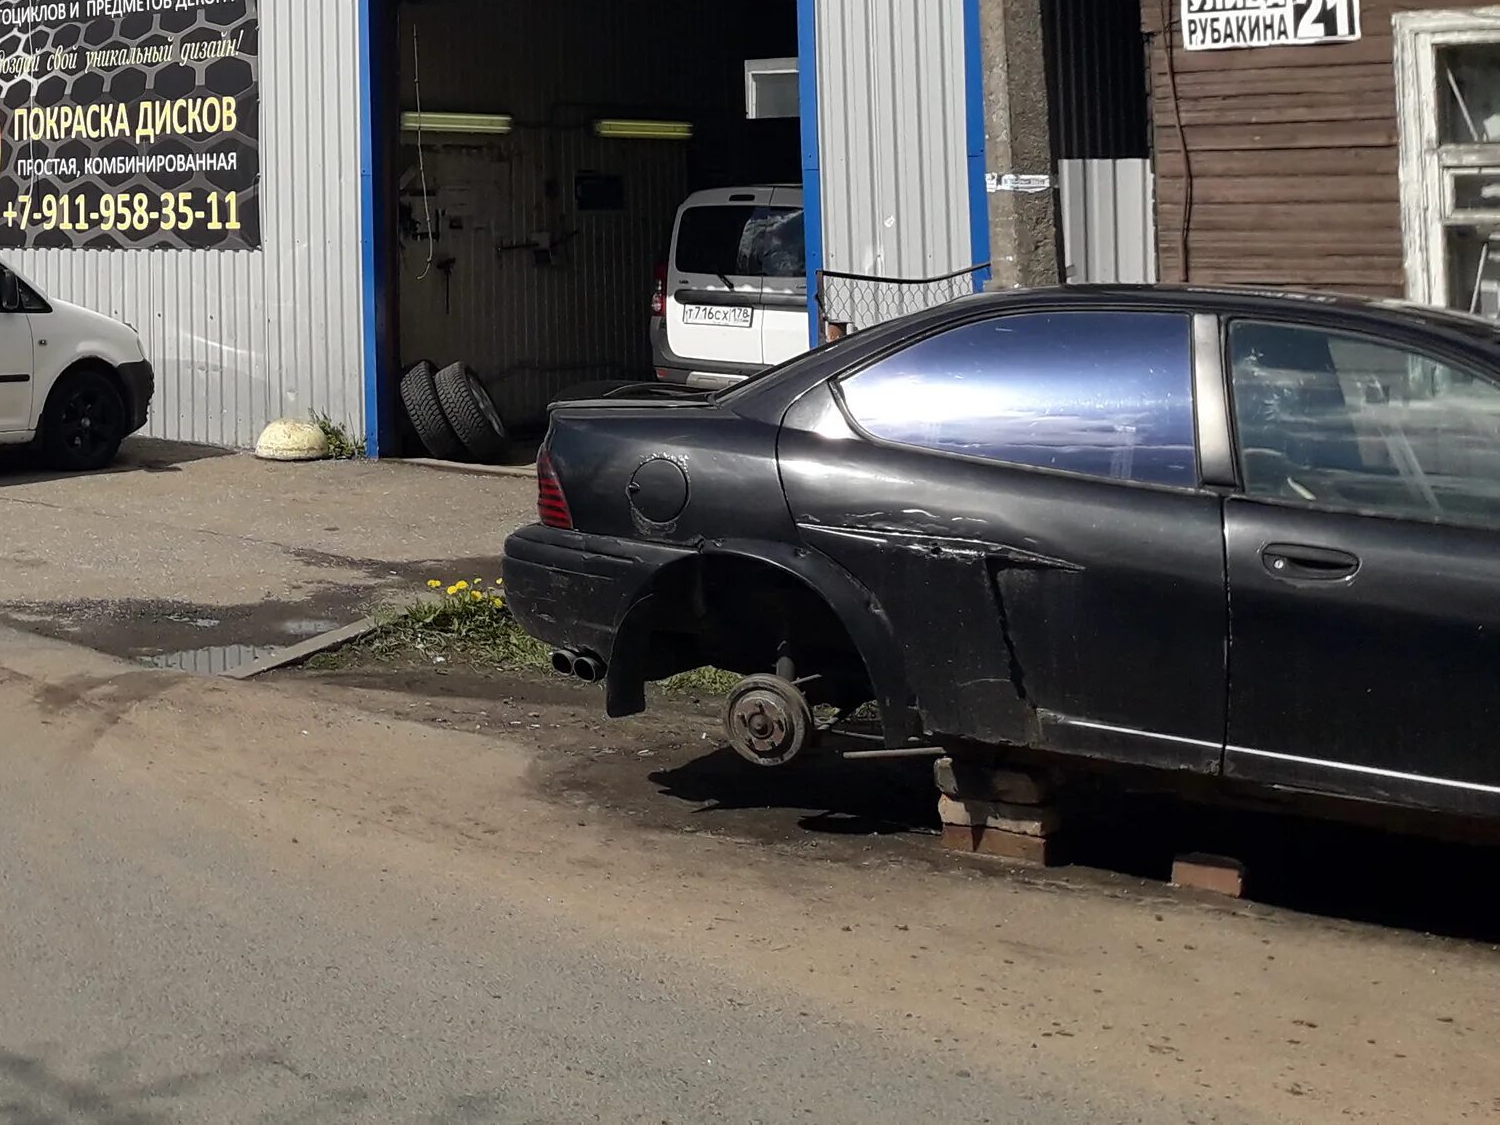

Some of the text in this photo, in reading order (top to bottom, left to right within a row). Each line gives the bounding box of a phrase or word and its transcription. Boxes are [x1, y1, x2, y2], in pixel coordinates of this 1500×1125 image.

[69, 1, 80, 19] И
[1187, 14, 1289, 45] РУБАКИНА
[46, 45, 79, 72] свой
[85, 36, 175, 75] уникальный
[179, 29, 245, 66] дизайн!
[13, 95, 238, 145] ПОКРАСКА ДИСКОВ
[17, 151, 238, 178] ПРОСТАЯ, КОМБИНИРОВАННАЯ
[2, 190, 241, 231] +7-911-958-35-11
